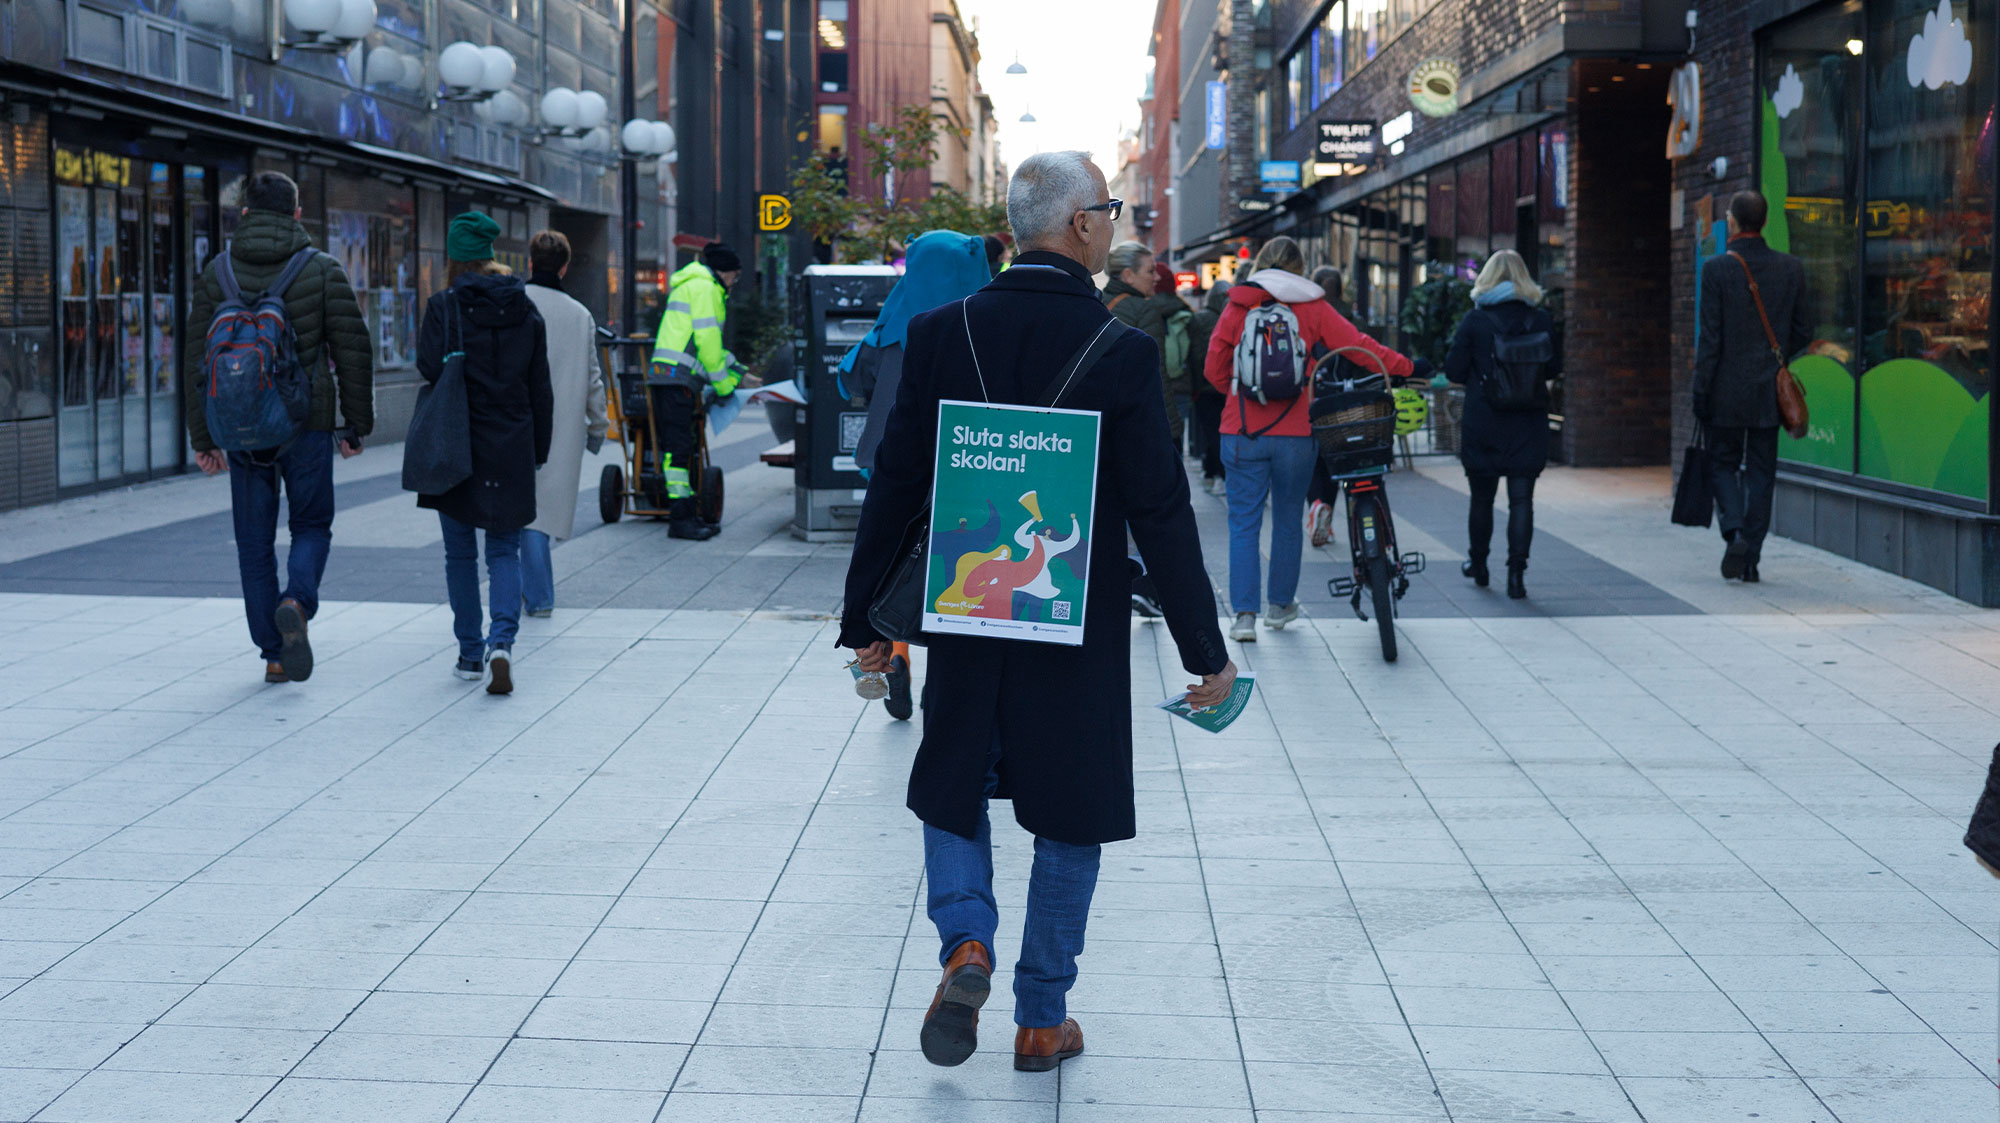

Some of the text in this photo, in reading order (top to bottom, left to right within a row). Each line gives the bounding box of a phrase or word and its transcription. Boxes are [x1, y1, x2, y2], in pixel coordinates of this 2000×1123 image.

[1321, 125, 1372, 137] TWILFIT
[1320, 141, 1374, 154] CHANGE
[952, 425, 1073, 453] Sluta slakta
[950, 449, 1026, 473] skolan!
